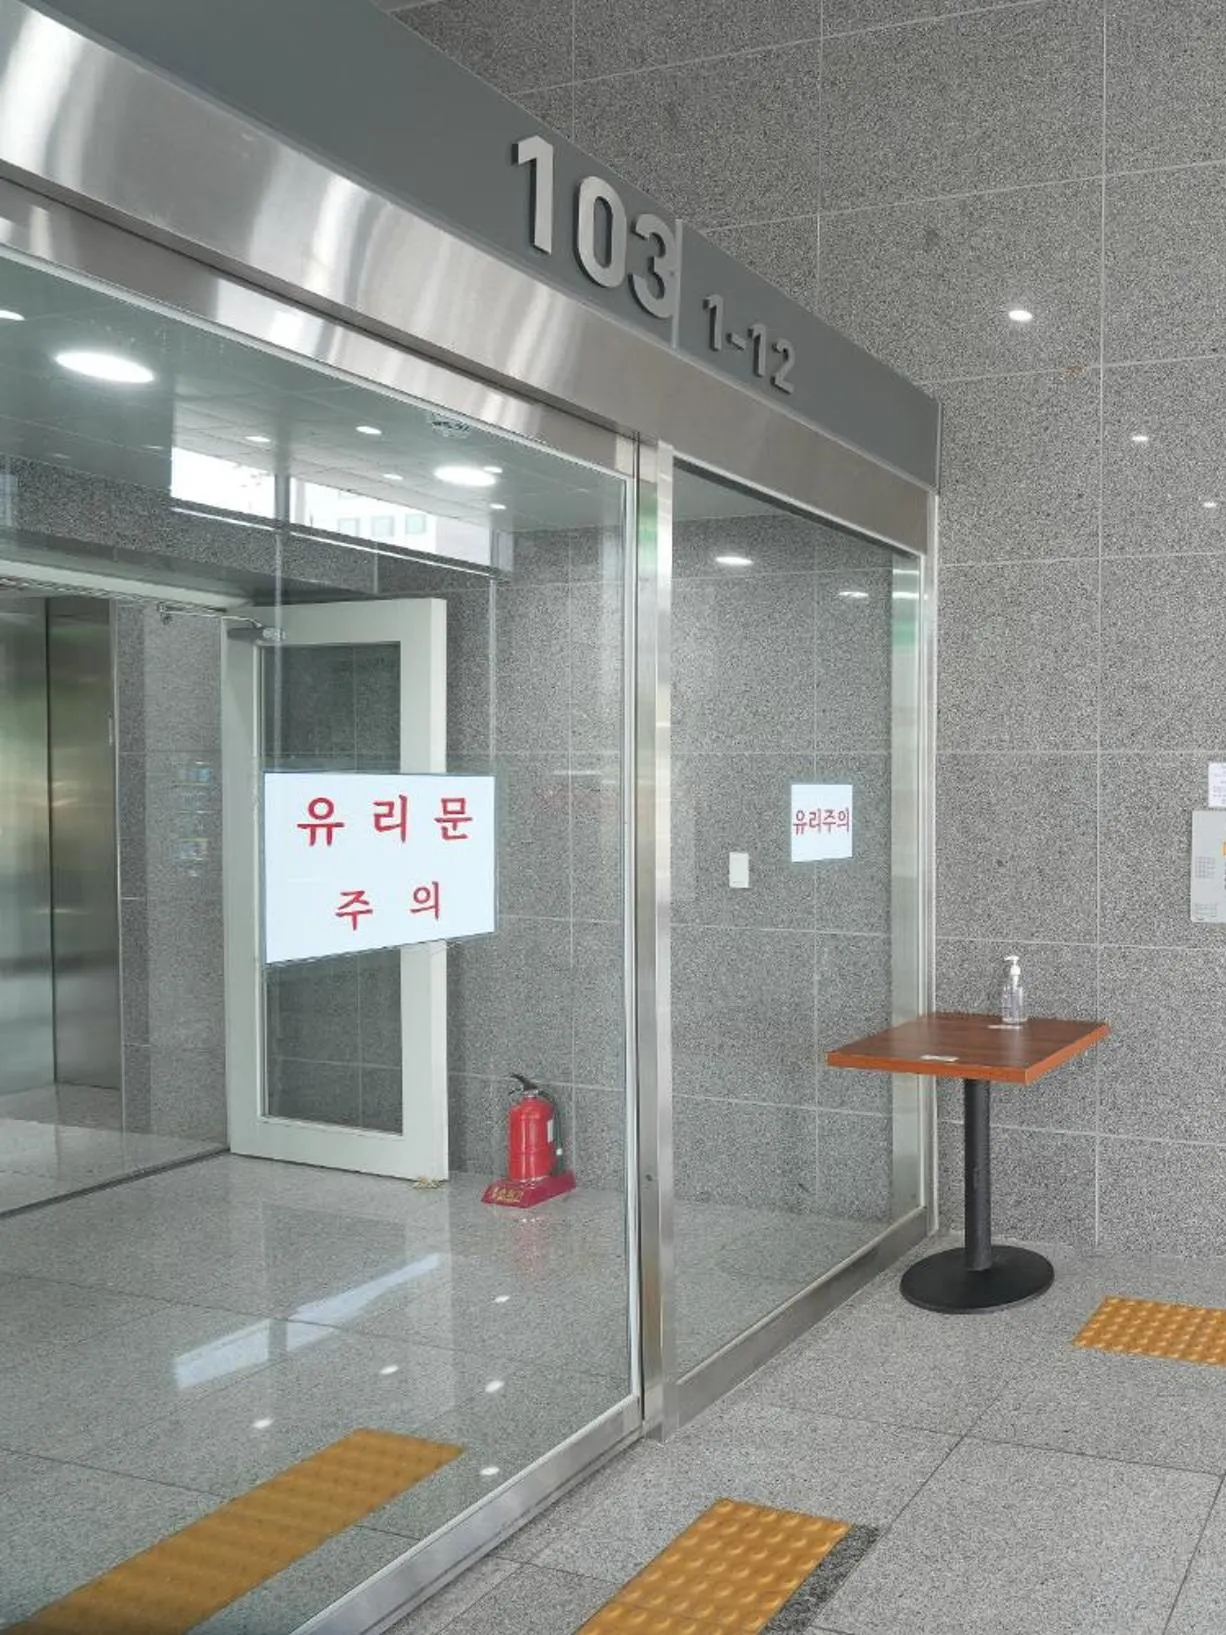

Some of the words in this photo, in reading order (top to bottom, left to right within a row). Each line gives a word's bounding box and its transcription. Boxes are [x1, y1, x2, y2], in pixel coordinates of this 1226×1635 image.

[512, 135, 677, 319] 103
[703, 294, 796, 395] 1-12
[793, 806, 850, 835] 유리주의
